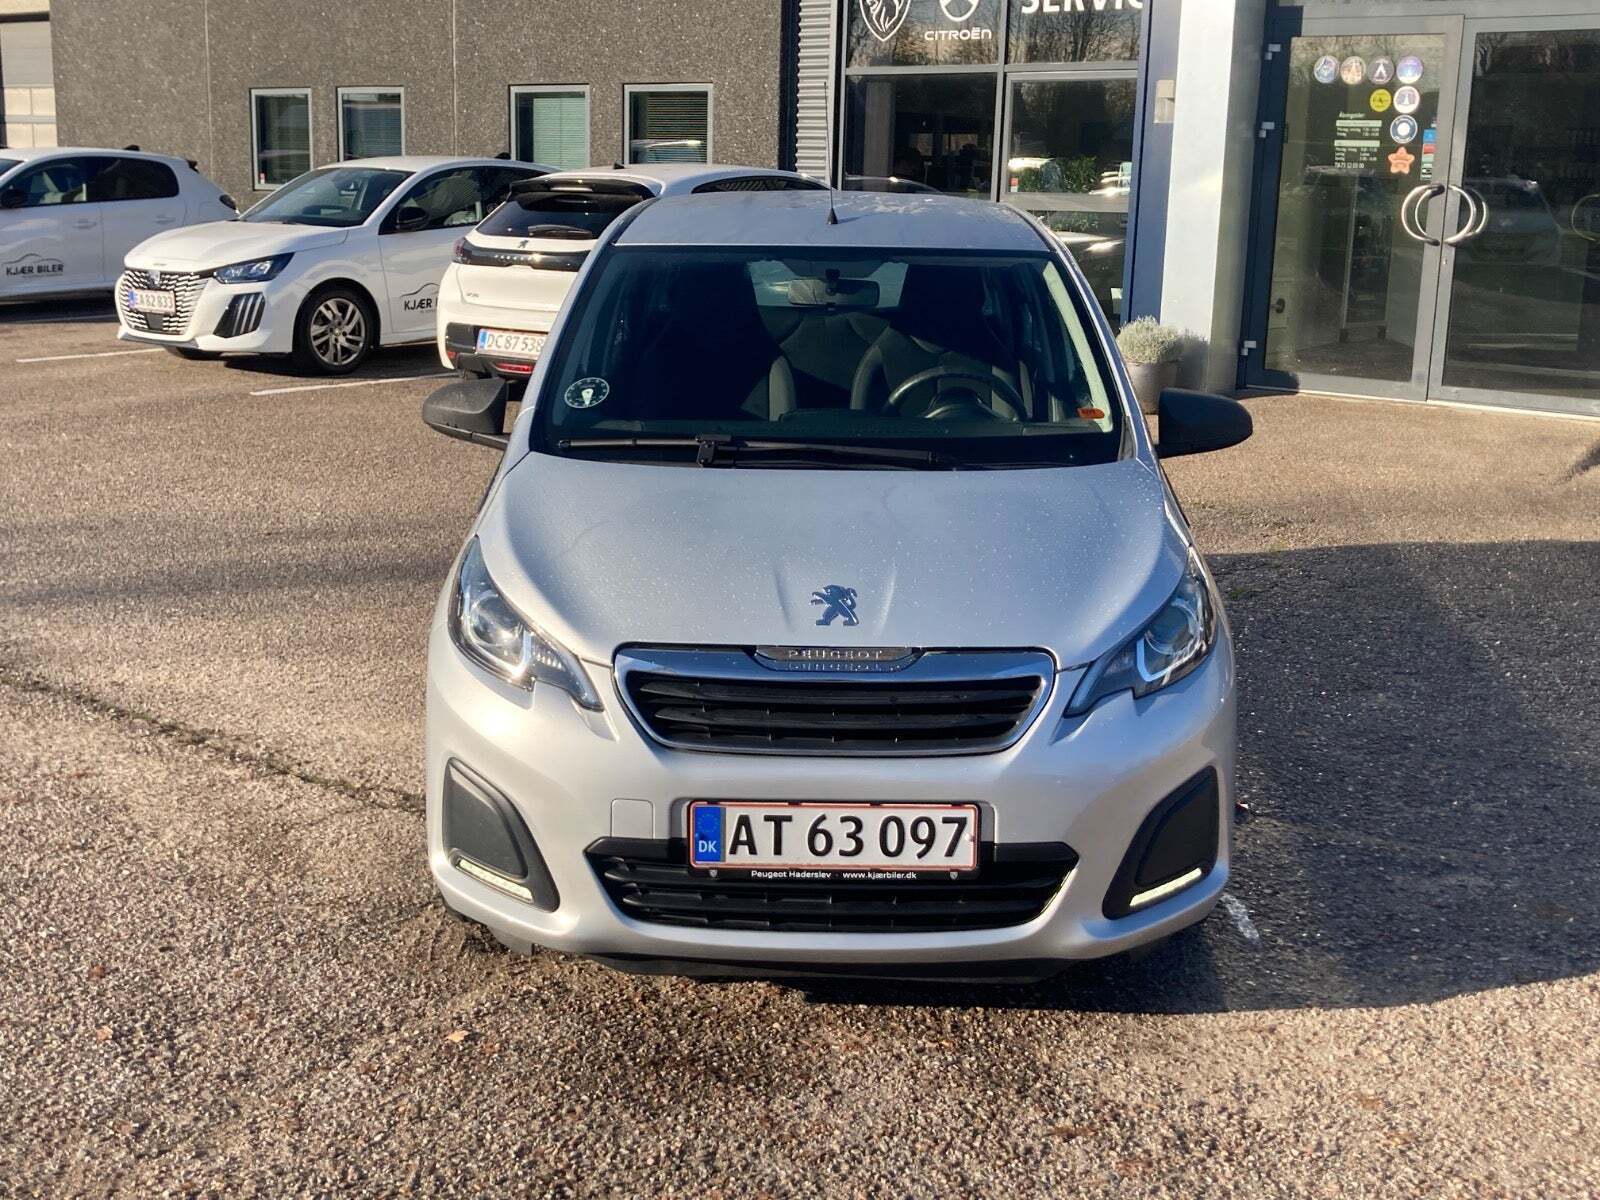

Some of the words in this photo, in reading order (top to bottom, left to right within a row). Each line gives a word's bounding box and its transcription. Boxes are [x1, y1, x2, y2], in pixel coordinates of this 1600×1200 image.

[6, 265, 34, 276] KJÆR
[37, 263, 64, 274] BILER
[404, 298, 433, 311] KJÆR
[488, 334, 503, 349] DC
[504, 335, 520, 350] 87
[788, 649, 883, 659] PEUGEOT
[729, 815, 793, 856] AT
[807, 814, 864, 857] 63
[879, 815, 968, 859] 097
[698, 840, 717, 853] DK
[751, 870, 787, 879] Peugeot
[788, 870, 831, 879] Haderslev
[842, 871, 917, 880] www.kjærbiler.dk
